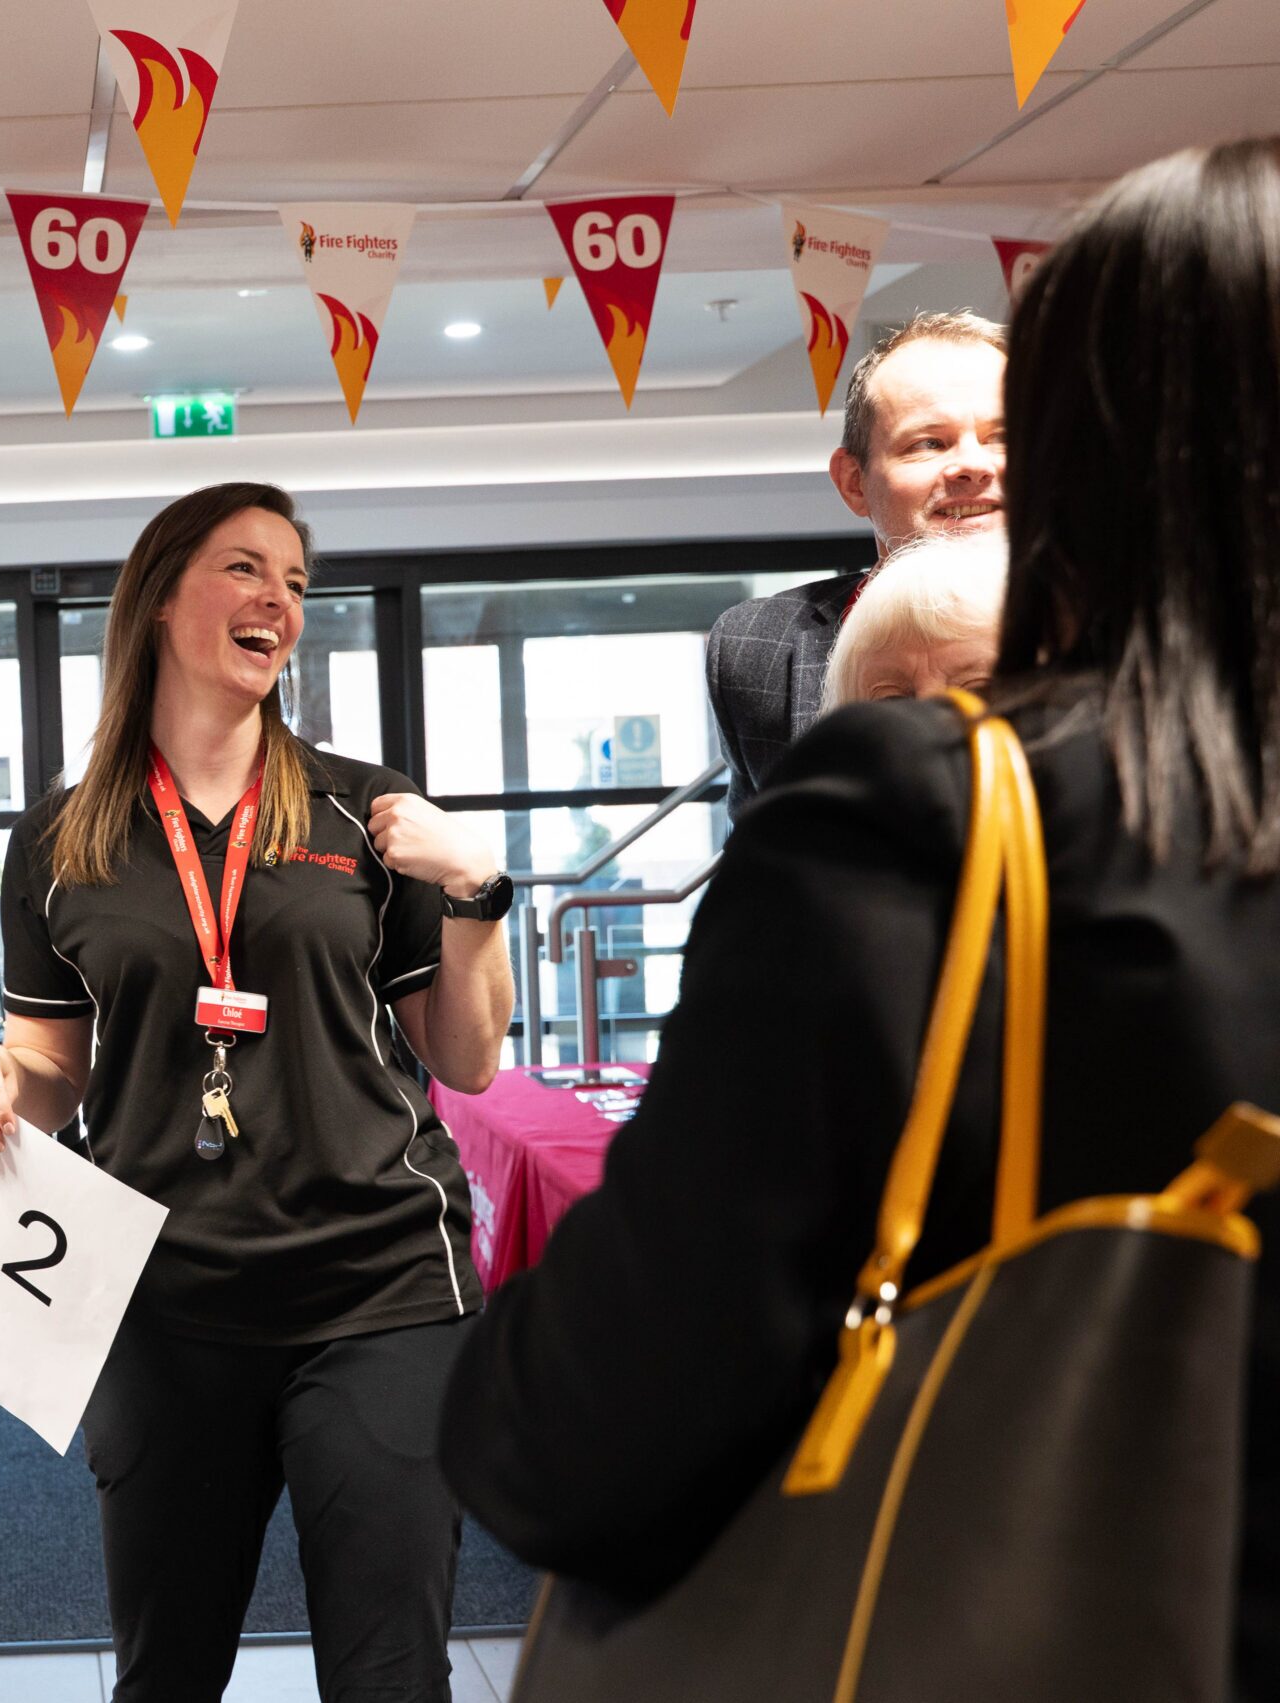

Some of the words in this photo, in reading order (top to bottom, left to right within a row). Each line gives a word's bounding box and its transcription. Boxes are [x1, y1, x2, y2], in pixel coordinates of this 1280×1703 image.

[30, 207, 127, 275] 60
[320, 234, 343, 248] Fire
[346, 234, 398, 252] Fighters
[572, 211, 662, 272] 60
[808, 236, 829, 252] Fire
[830, 240, 871, 260] Fighters
[368, 250, 396, 261] Charity
[171, 817, 180, 828] Fire
[239, 805, 250, 828] Fighters
[175, 827, 188, 852] Fighters
[236, 828, 246, 840] Fire
[308, 853, 358, 868] Fighters
[222, 1007, 243, 1019] Chloé
[1, 1210, 68, 1307] 2
